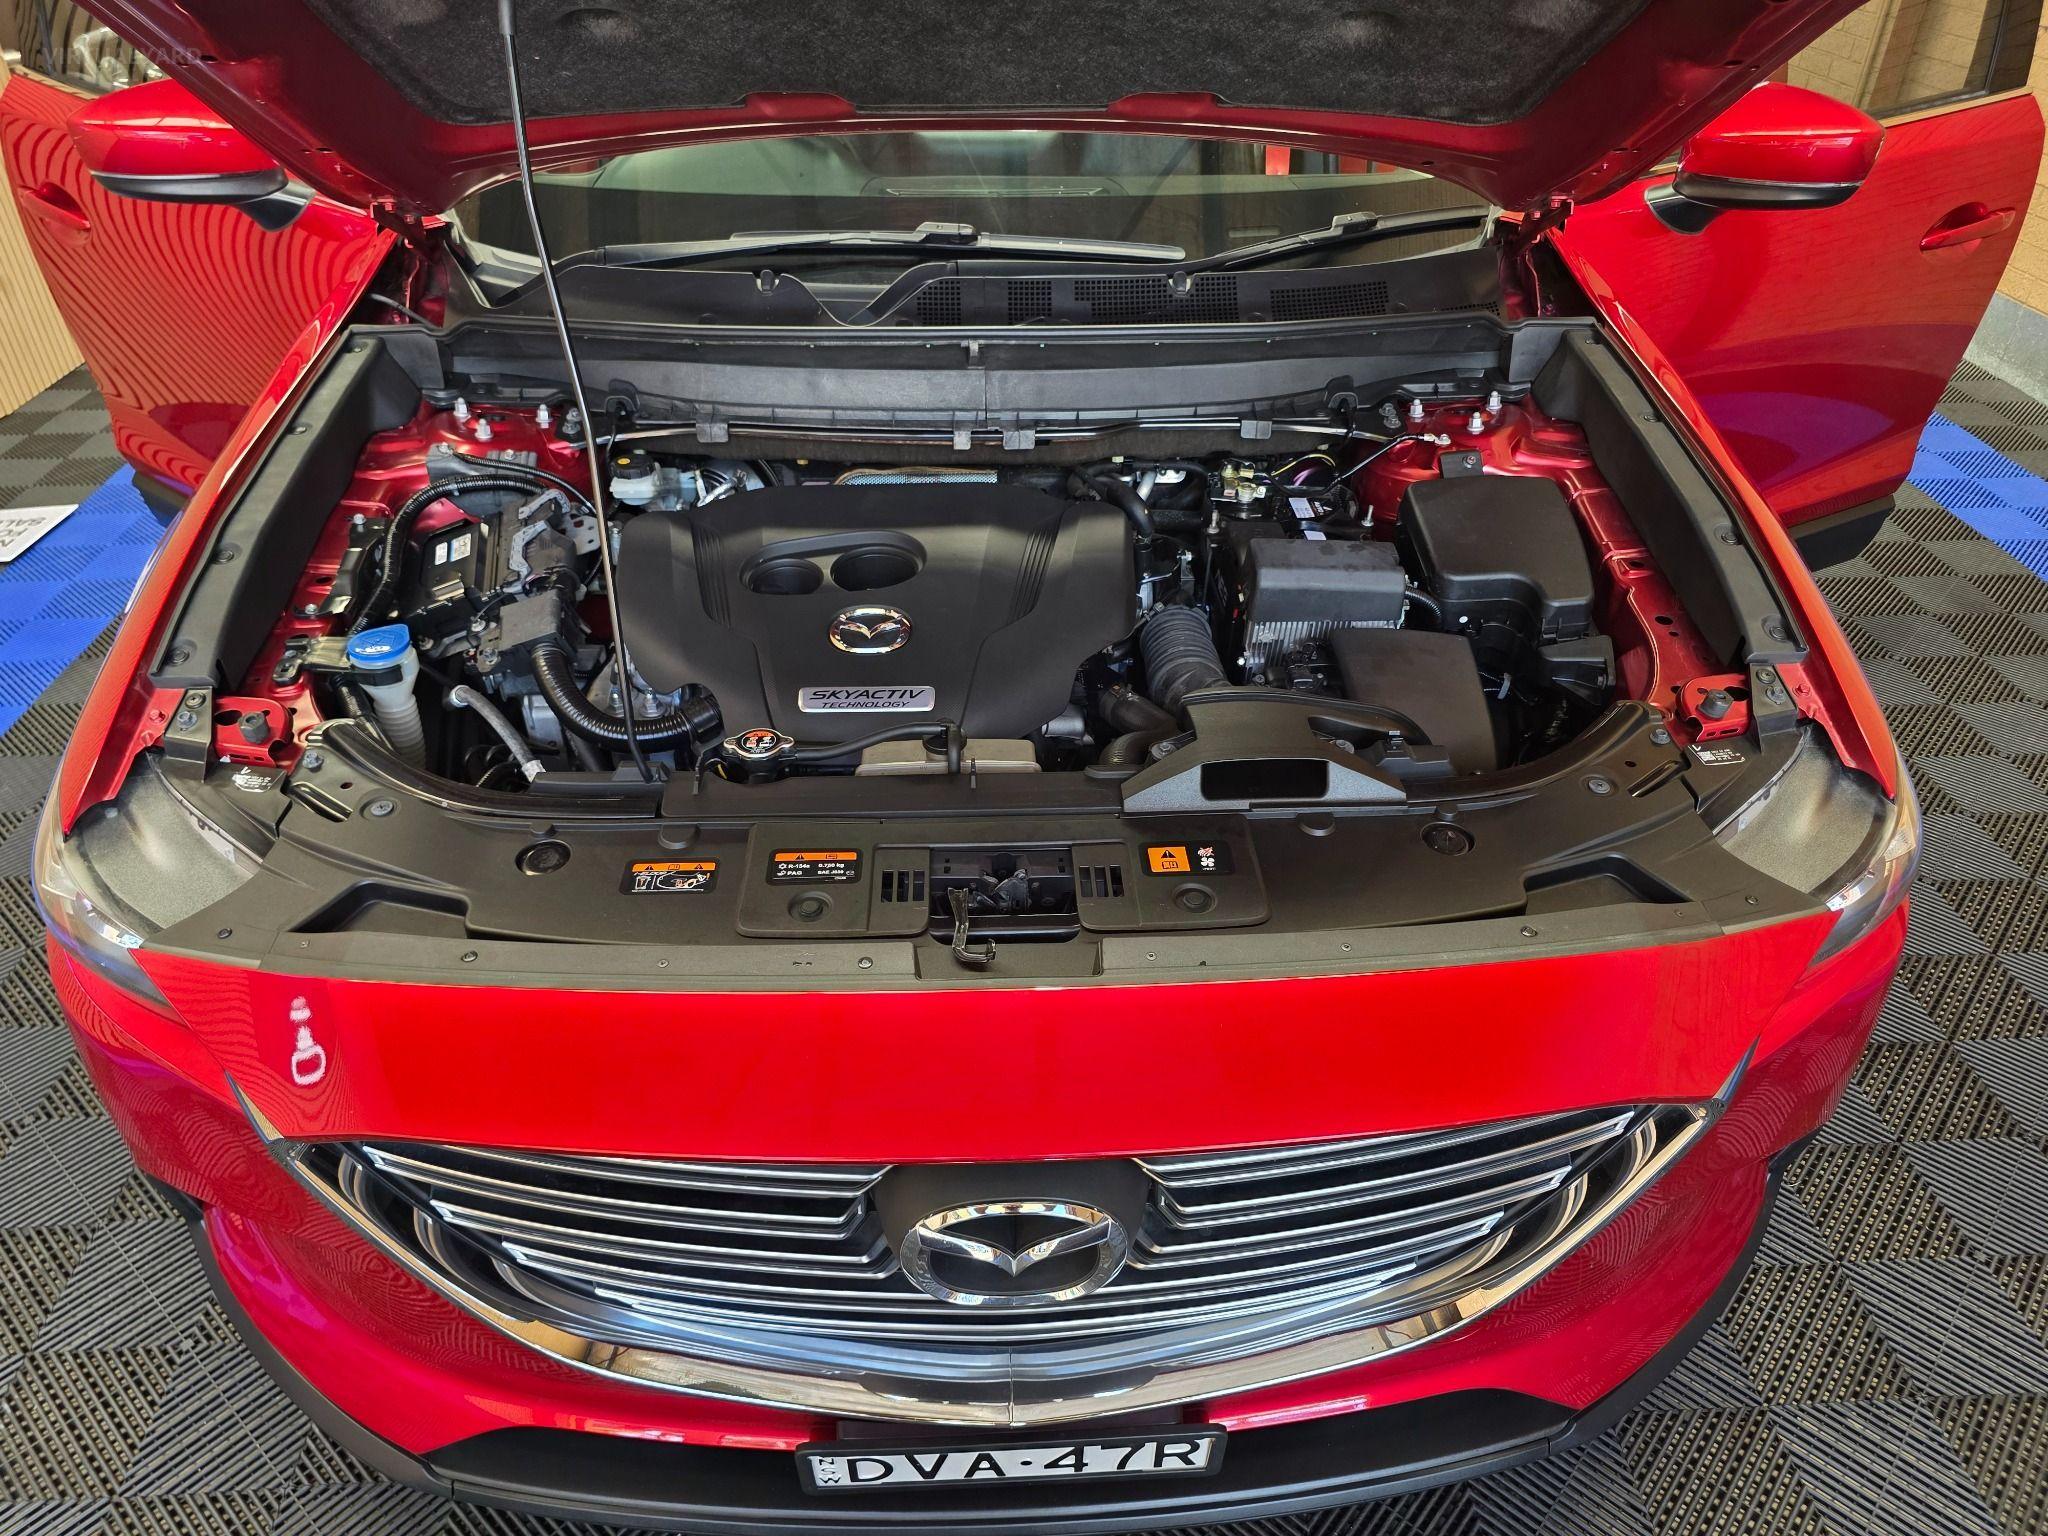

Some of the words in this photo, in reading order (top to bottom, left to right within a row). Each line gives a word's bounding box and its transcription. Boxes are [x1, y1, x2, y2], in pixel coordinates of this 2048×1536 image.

[809, 689, 926, 700] SKYACTIV
[821, 701, 910, 709] TECHNOLOGY
[817, 1456, 842, 1484] NSW
